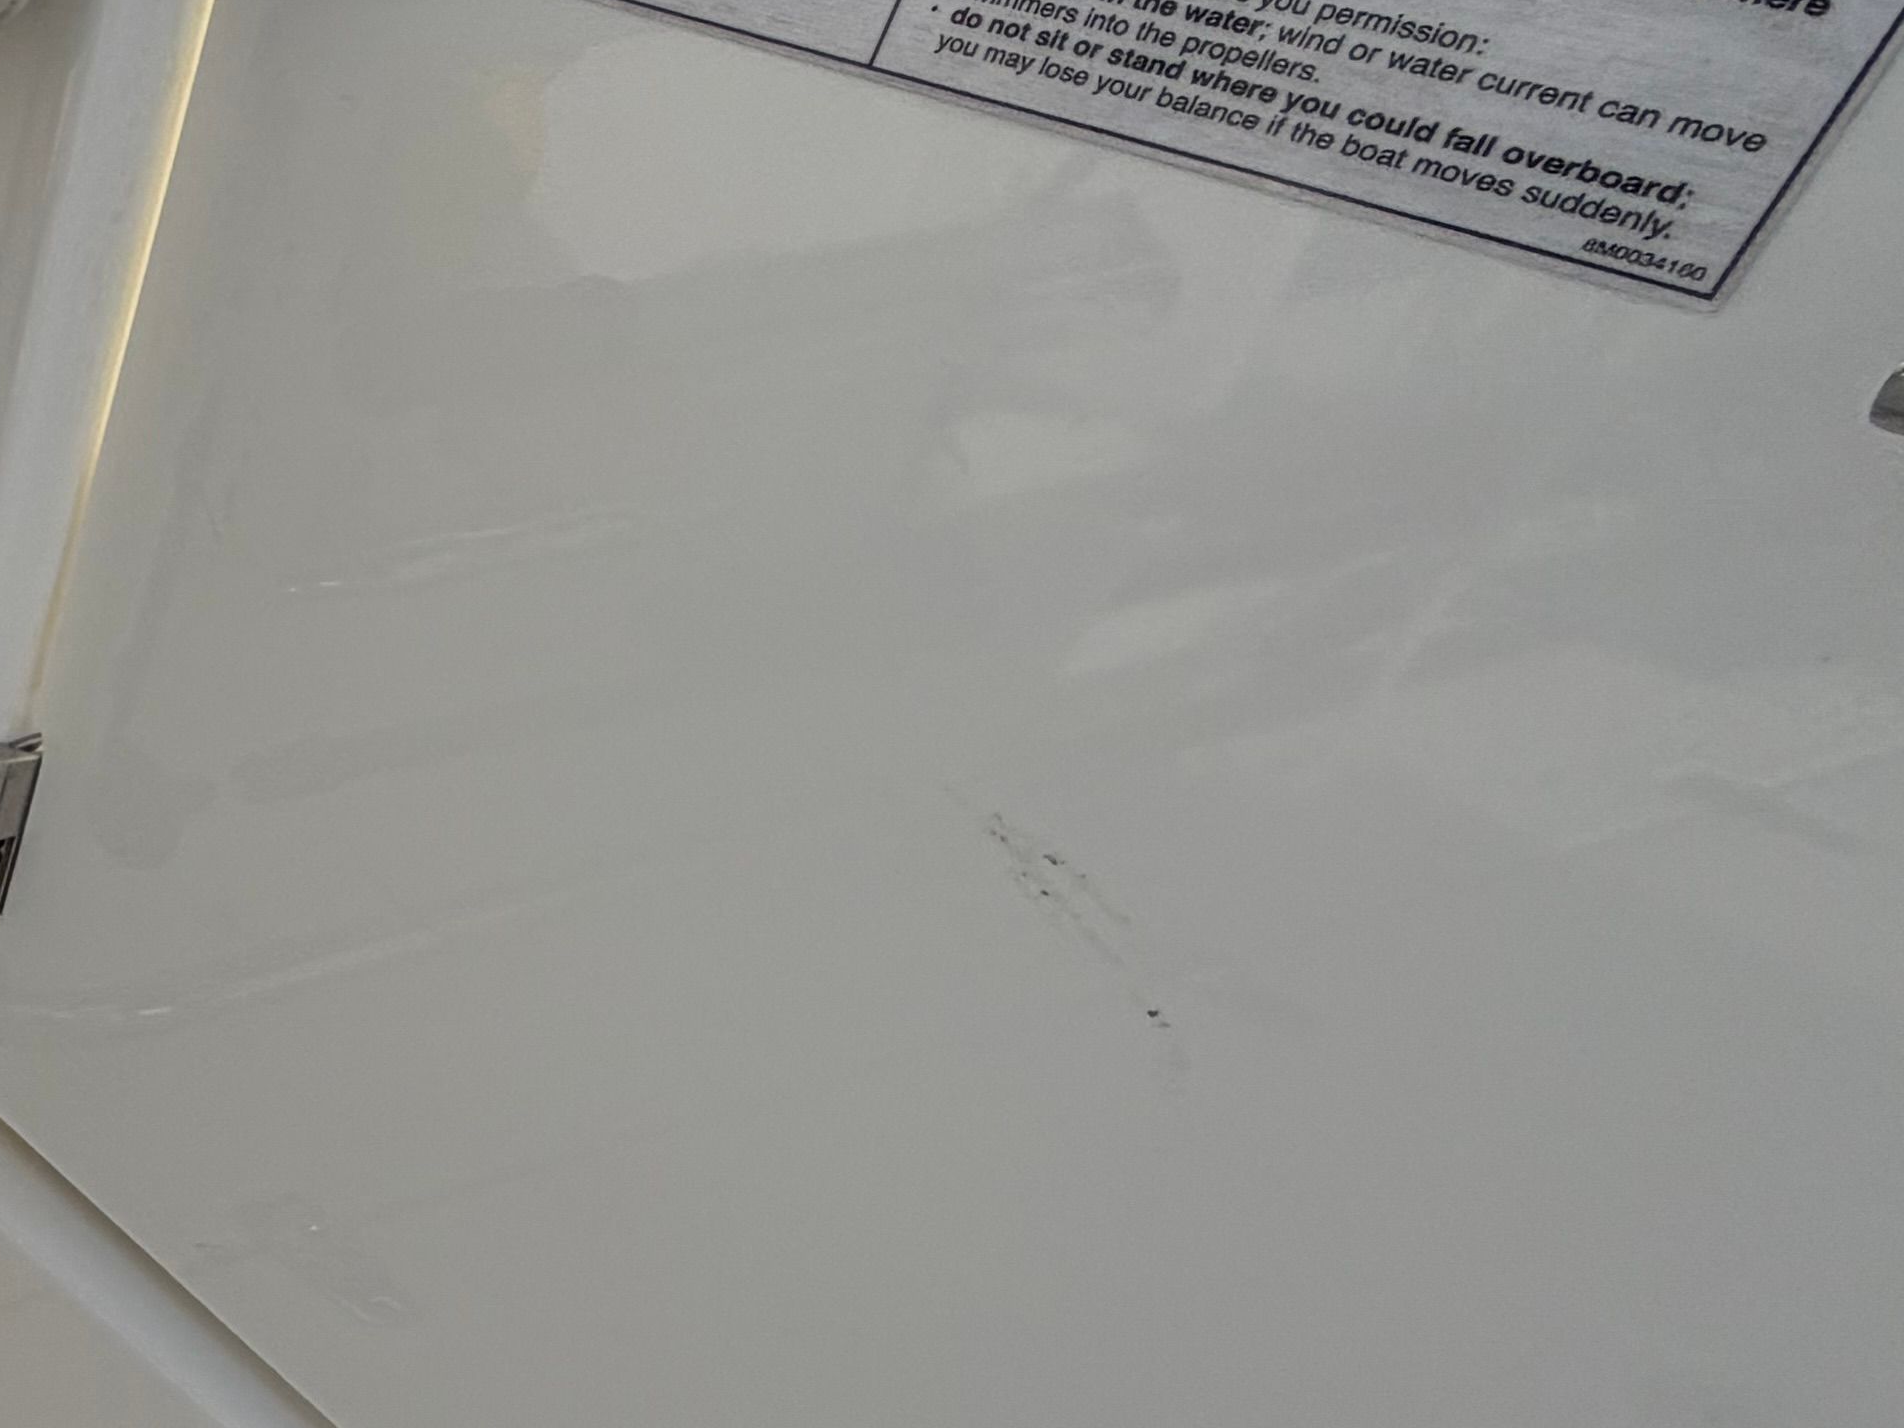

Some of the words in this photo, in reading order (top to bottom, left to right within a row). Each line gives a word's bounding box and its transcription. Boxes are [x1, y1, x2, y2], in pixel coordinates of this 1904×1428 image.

[1083, 7, 1130, 36] into
[1136, 22, 1176, 47] the
[1179, 36, 1319, 83] propellers.
[1185, 4, 1272, 41] water;
[1278, 26, 1346, 55] wind
[1348, 43, 1383, 64] or
[1388, 51, 1475, 84] water
[1477, 72, 1594, 113] current
[1597, 100, 1662, 129] can
[1667, 116, 1768, 153] move
[1313, 3, 1490, 56] permission:
[933, 34, 979, 57] you
[983, 46, 1036, 76] may
[1038, 56, 1089, 86] lose
[1091, 75, 1153, 102] your
[1155, 86, 1261, 131] balance
[1265, 115, 1288, 137] if
[1290, 122, 1335, 150] the
[1339, 134, 1409, 169] boat
[1411, 157, 1515, 197] moves
[1520, 186, 1674, 240] suddenly.
[950, 7, 983, 29] do
[987, 18, 1032, 42] not
[1034, 29, 1069, 51] sit
[1073, 40, 1104, 59] or
[1106, 48, 1187, 80] stand
[1190, 69, 1278, 104] where
[1280, 92, 1342, 120] you
[1346, 108, 1441, 144] could
[1442, 127, 1499, 157] fall
[1501, 146, 1695, 210] overboard;
